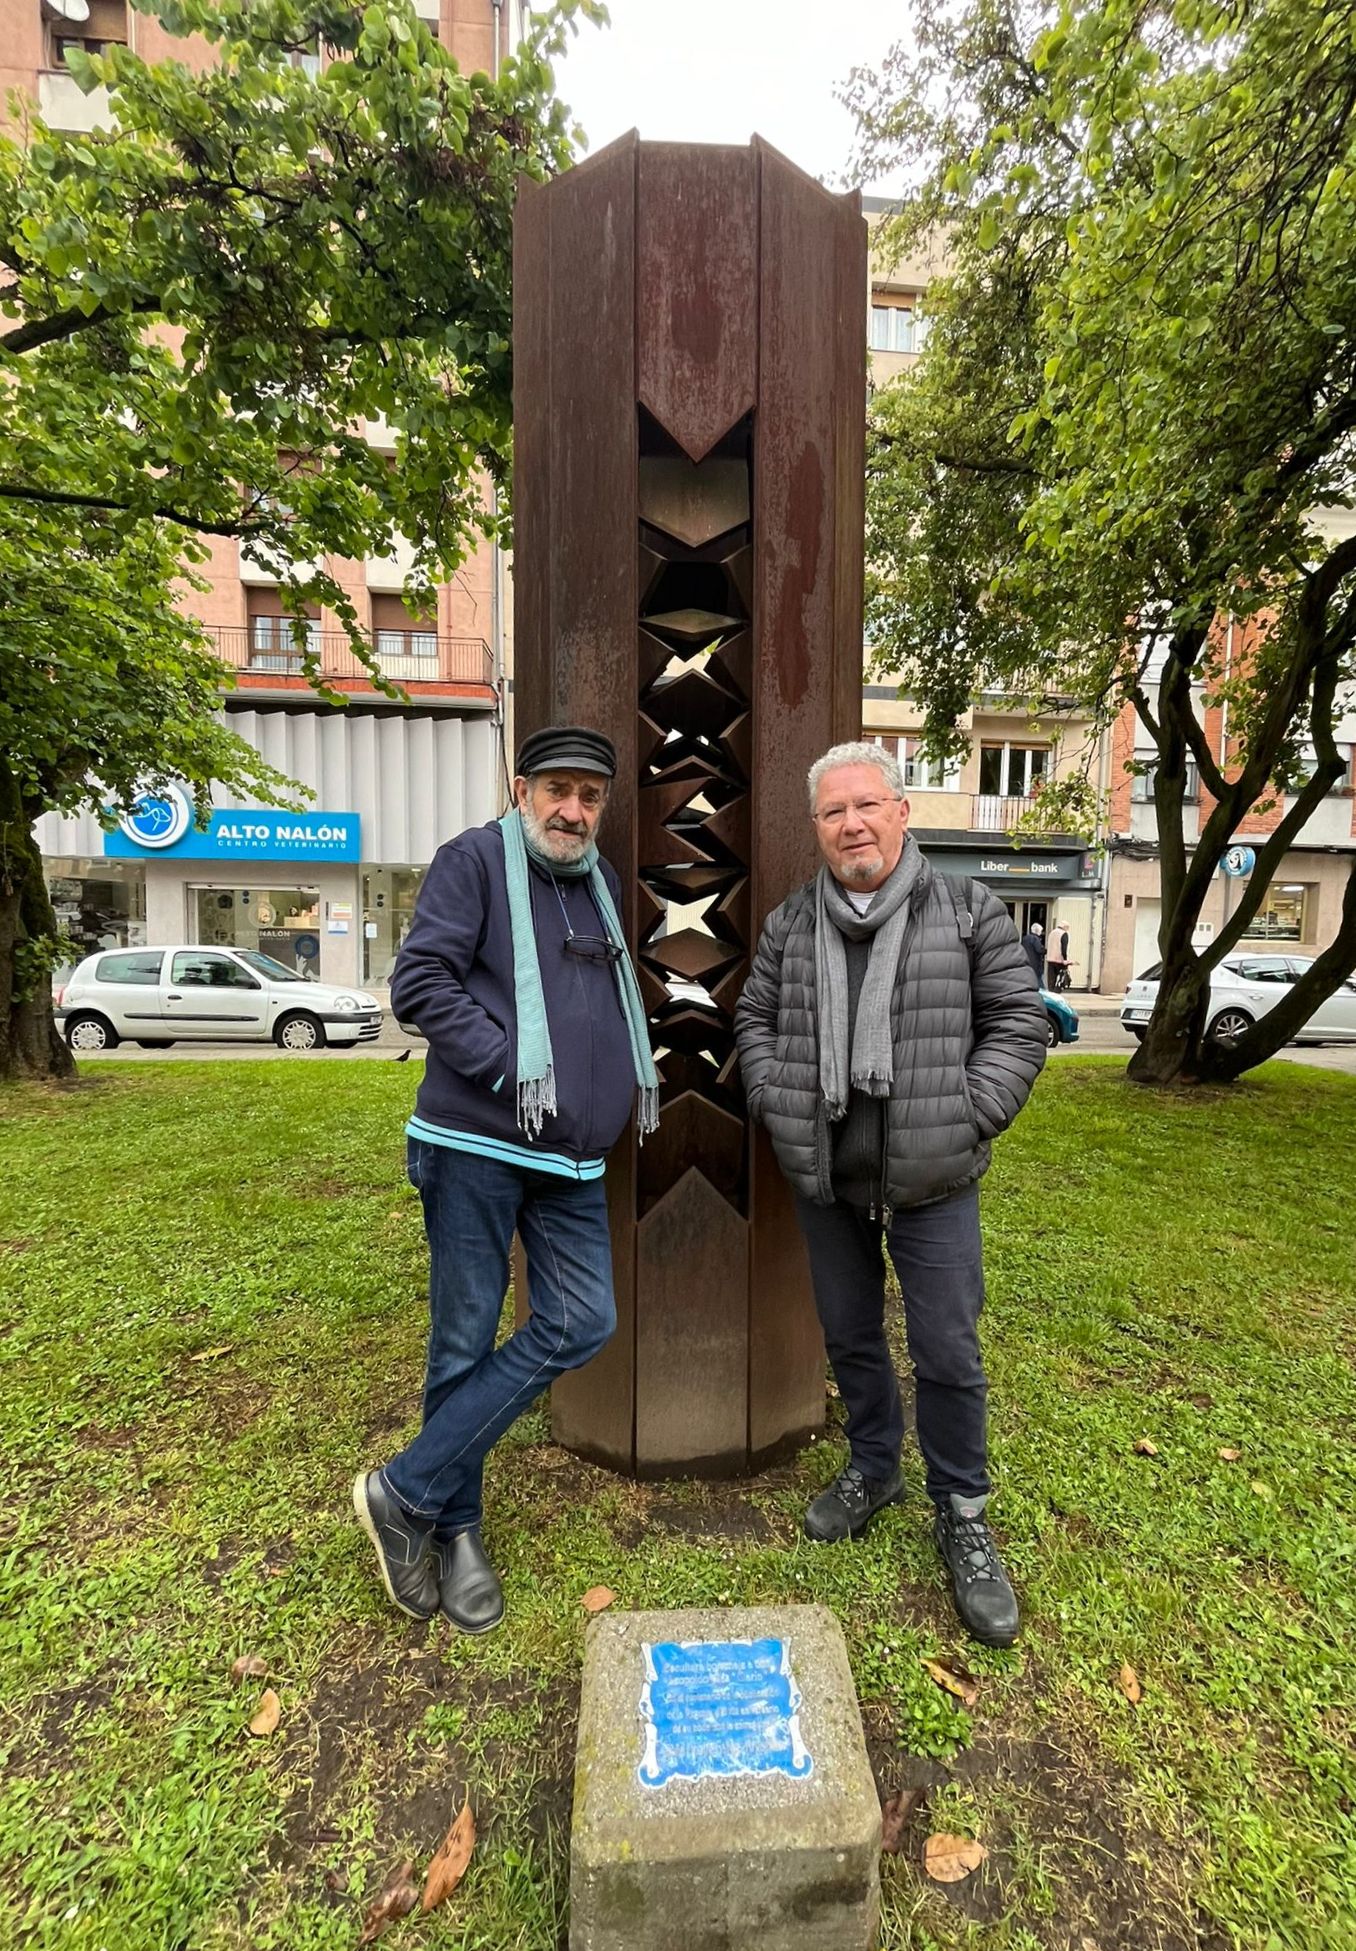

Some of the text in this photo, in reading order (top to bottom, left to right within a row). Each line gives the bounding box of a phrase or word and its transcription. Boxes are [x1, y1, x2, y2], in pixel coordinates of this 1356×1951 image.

[216, 824, 347, 841] ALTO NALÓN
[217, 840, 347, 849] CENTRO VETERINARIO
[980, 860, 1058, 873] Liber bank
